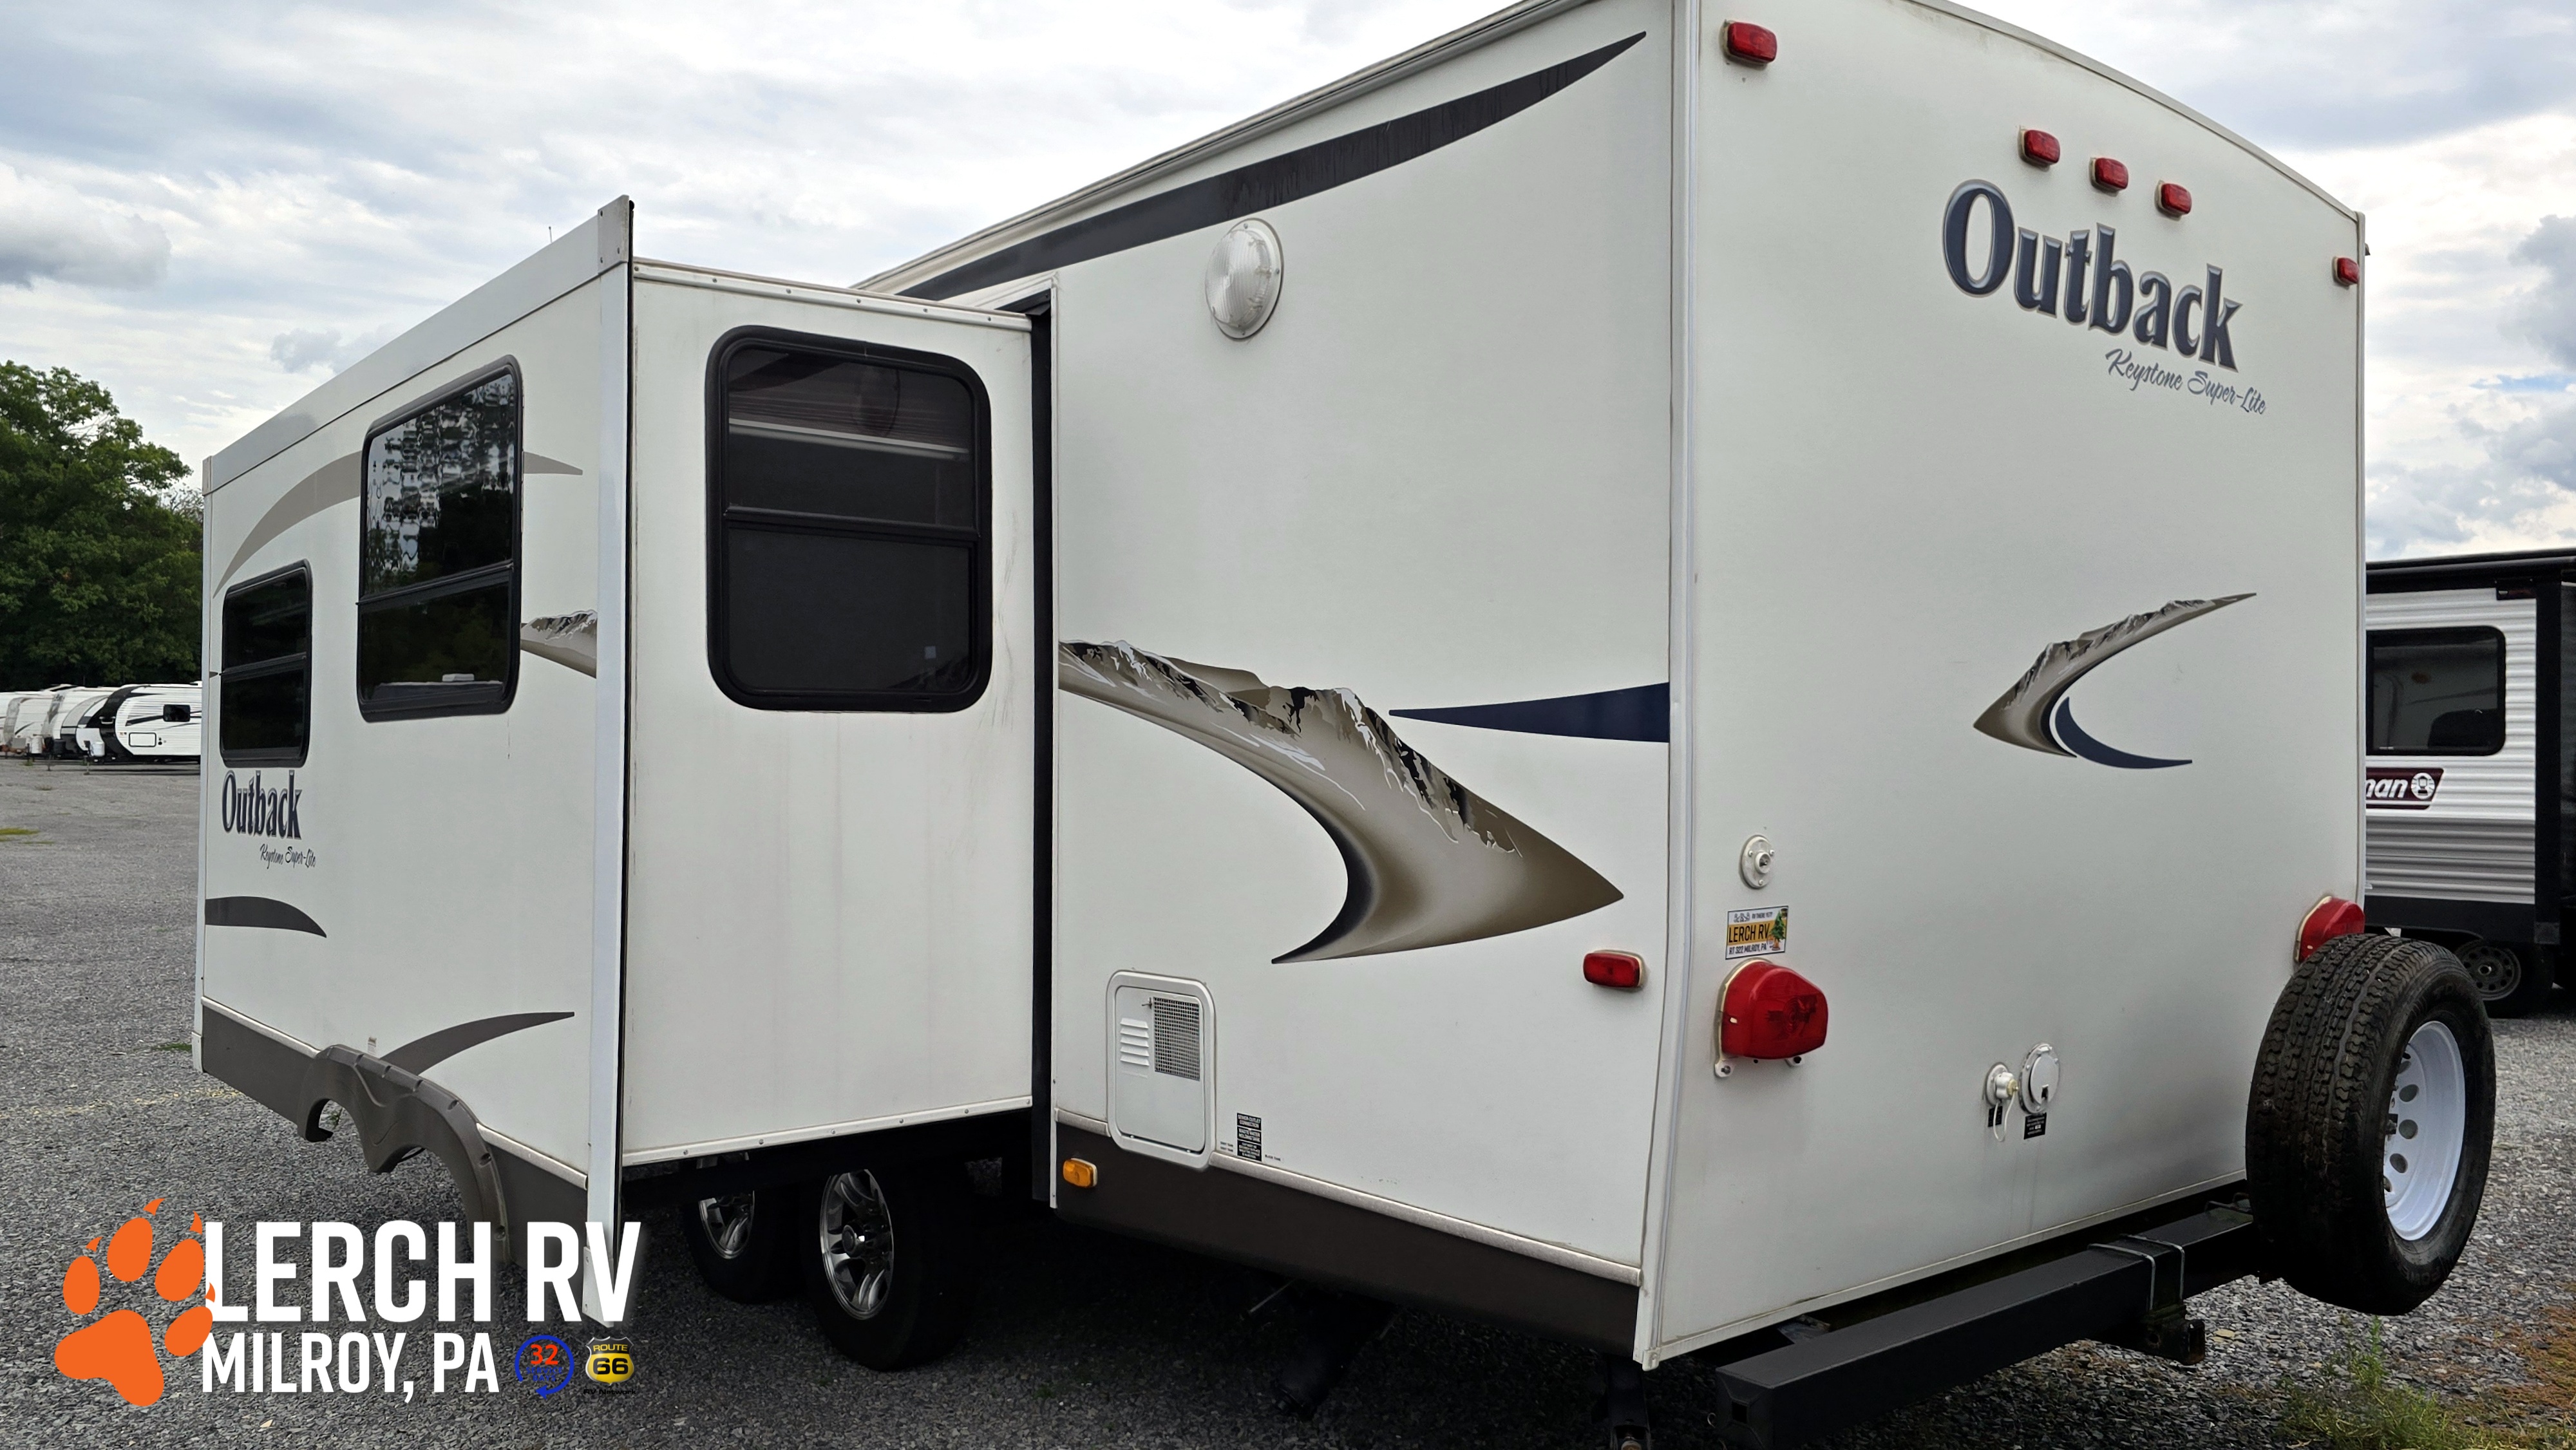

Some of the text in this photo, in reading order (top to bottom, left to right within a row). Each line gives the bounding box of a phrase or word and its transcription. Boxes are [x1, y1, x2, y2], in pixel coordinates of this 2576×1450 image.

[1942, 178, 2243, 373] Outback
[2105, 348, 2266, 415] Keystone Super-Lite
[222, 769, 303, 840] Outback
[260, 843, 316, 869] Keystone Super-Lite
[1728, 923, 1770, 943] LERCH RV
[1761, 943, 1767, 951] PA
